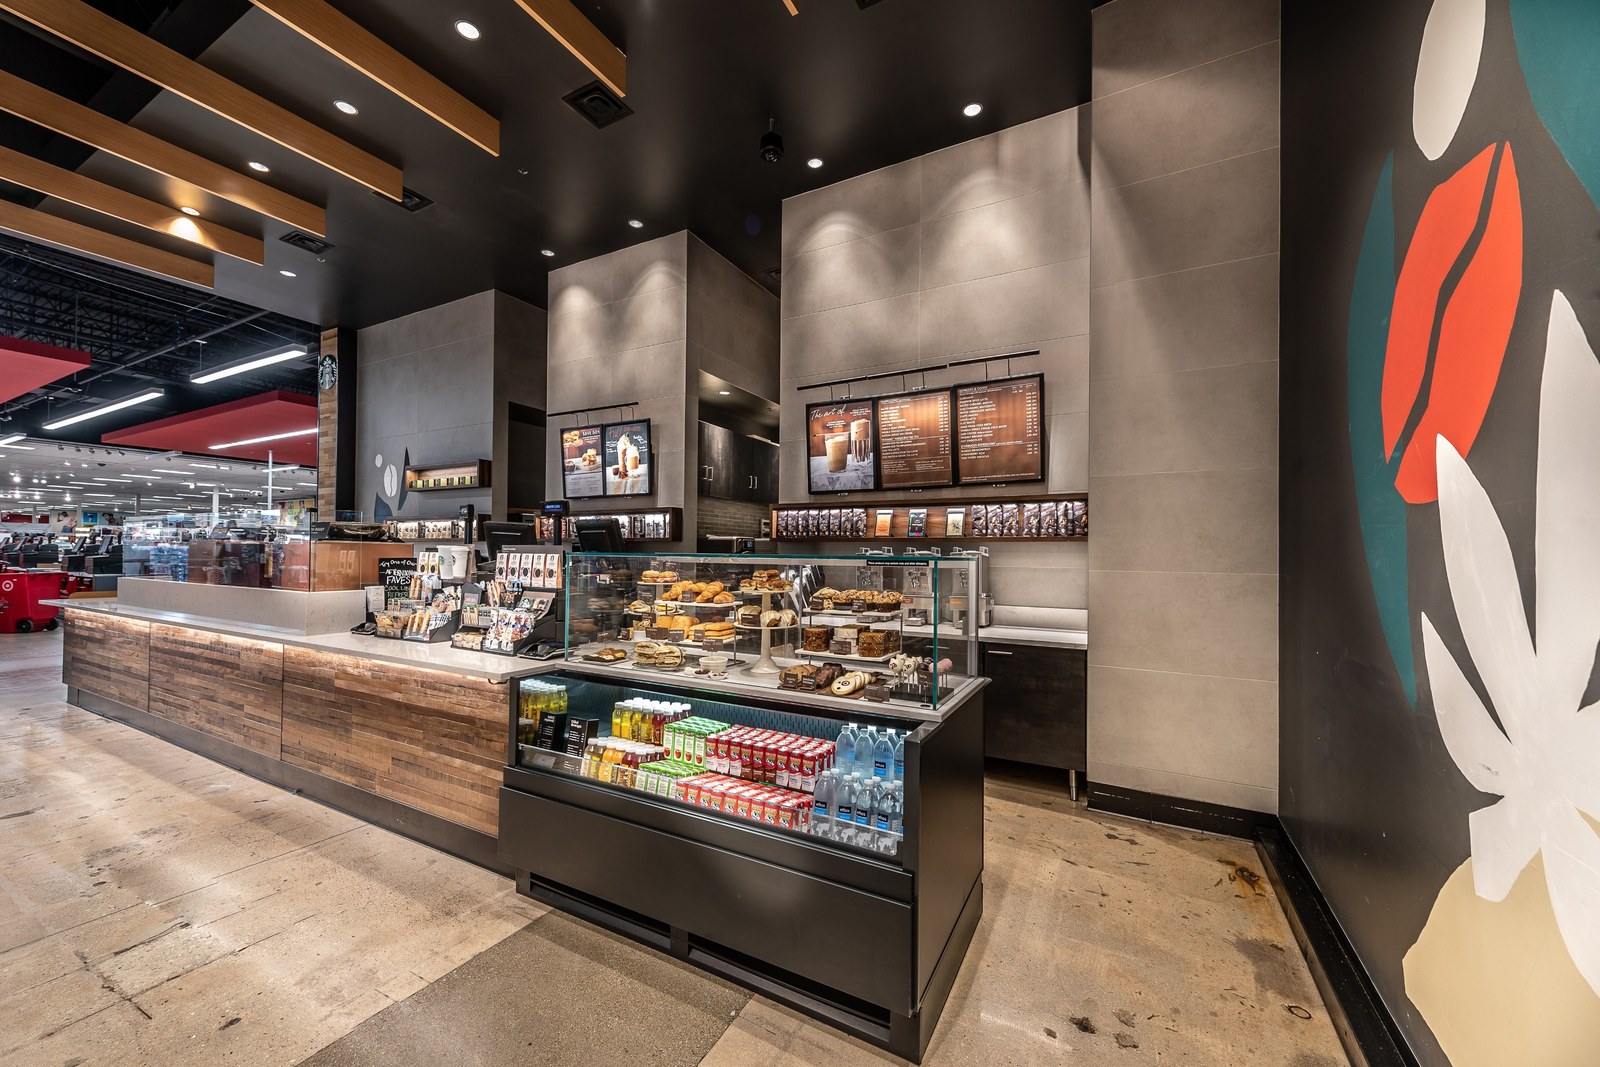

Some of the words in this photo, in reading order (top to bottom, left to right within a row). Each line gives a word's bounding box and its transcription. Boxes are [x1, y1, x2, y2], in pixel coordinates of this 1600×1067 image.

[810, 409, 823, 420] The
[824, 408, 836, 417] art
[837, 404, 847, 416] of
[386, 576, 410, 585] FAVES
